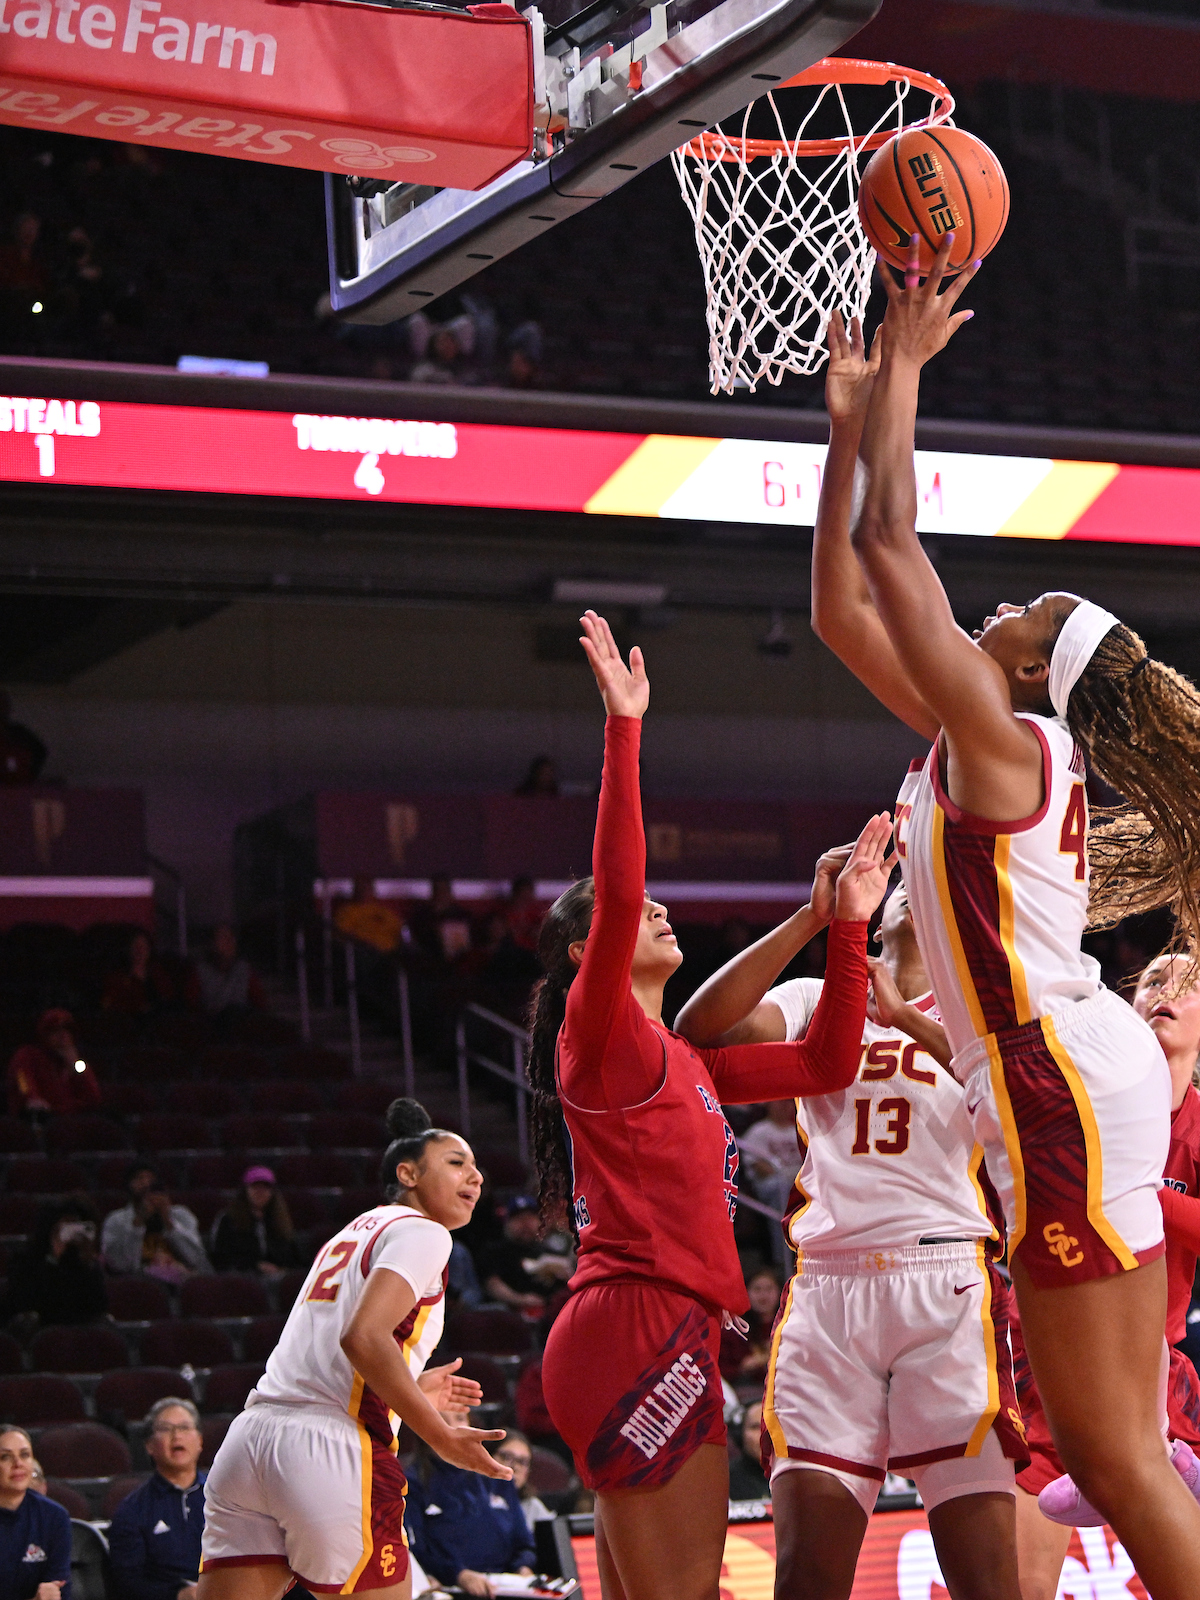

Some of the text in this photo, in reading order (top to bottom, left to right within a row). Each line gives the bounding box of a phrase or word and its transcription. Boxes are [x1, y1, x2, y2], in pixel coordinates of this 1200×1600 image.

[907, 152, 958, 236] ELITE
[0, 396, 101, 437] STEALS
[34, 434, 55, 477] 1
[1058, 781, 1088, 882] 4
[860, 1039, 938, 1089] SC
[851, 1097, 912, 1157] 13
[619, 1352, 707, 1460] BULLDOGS
